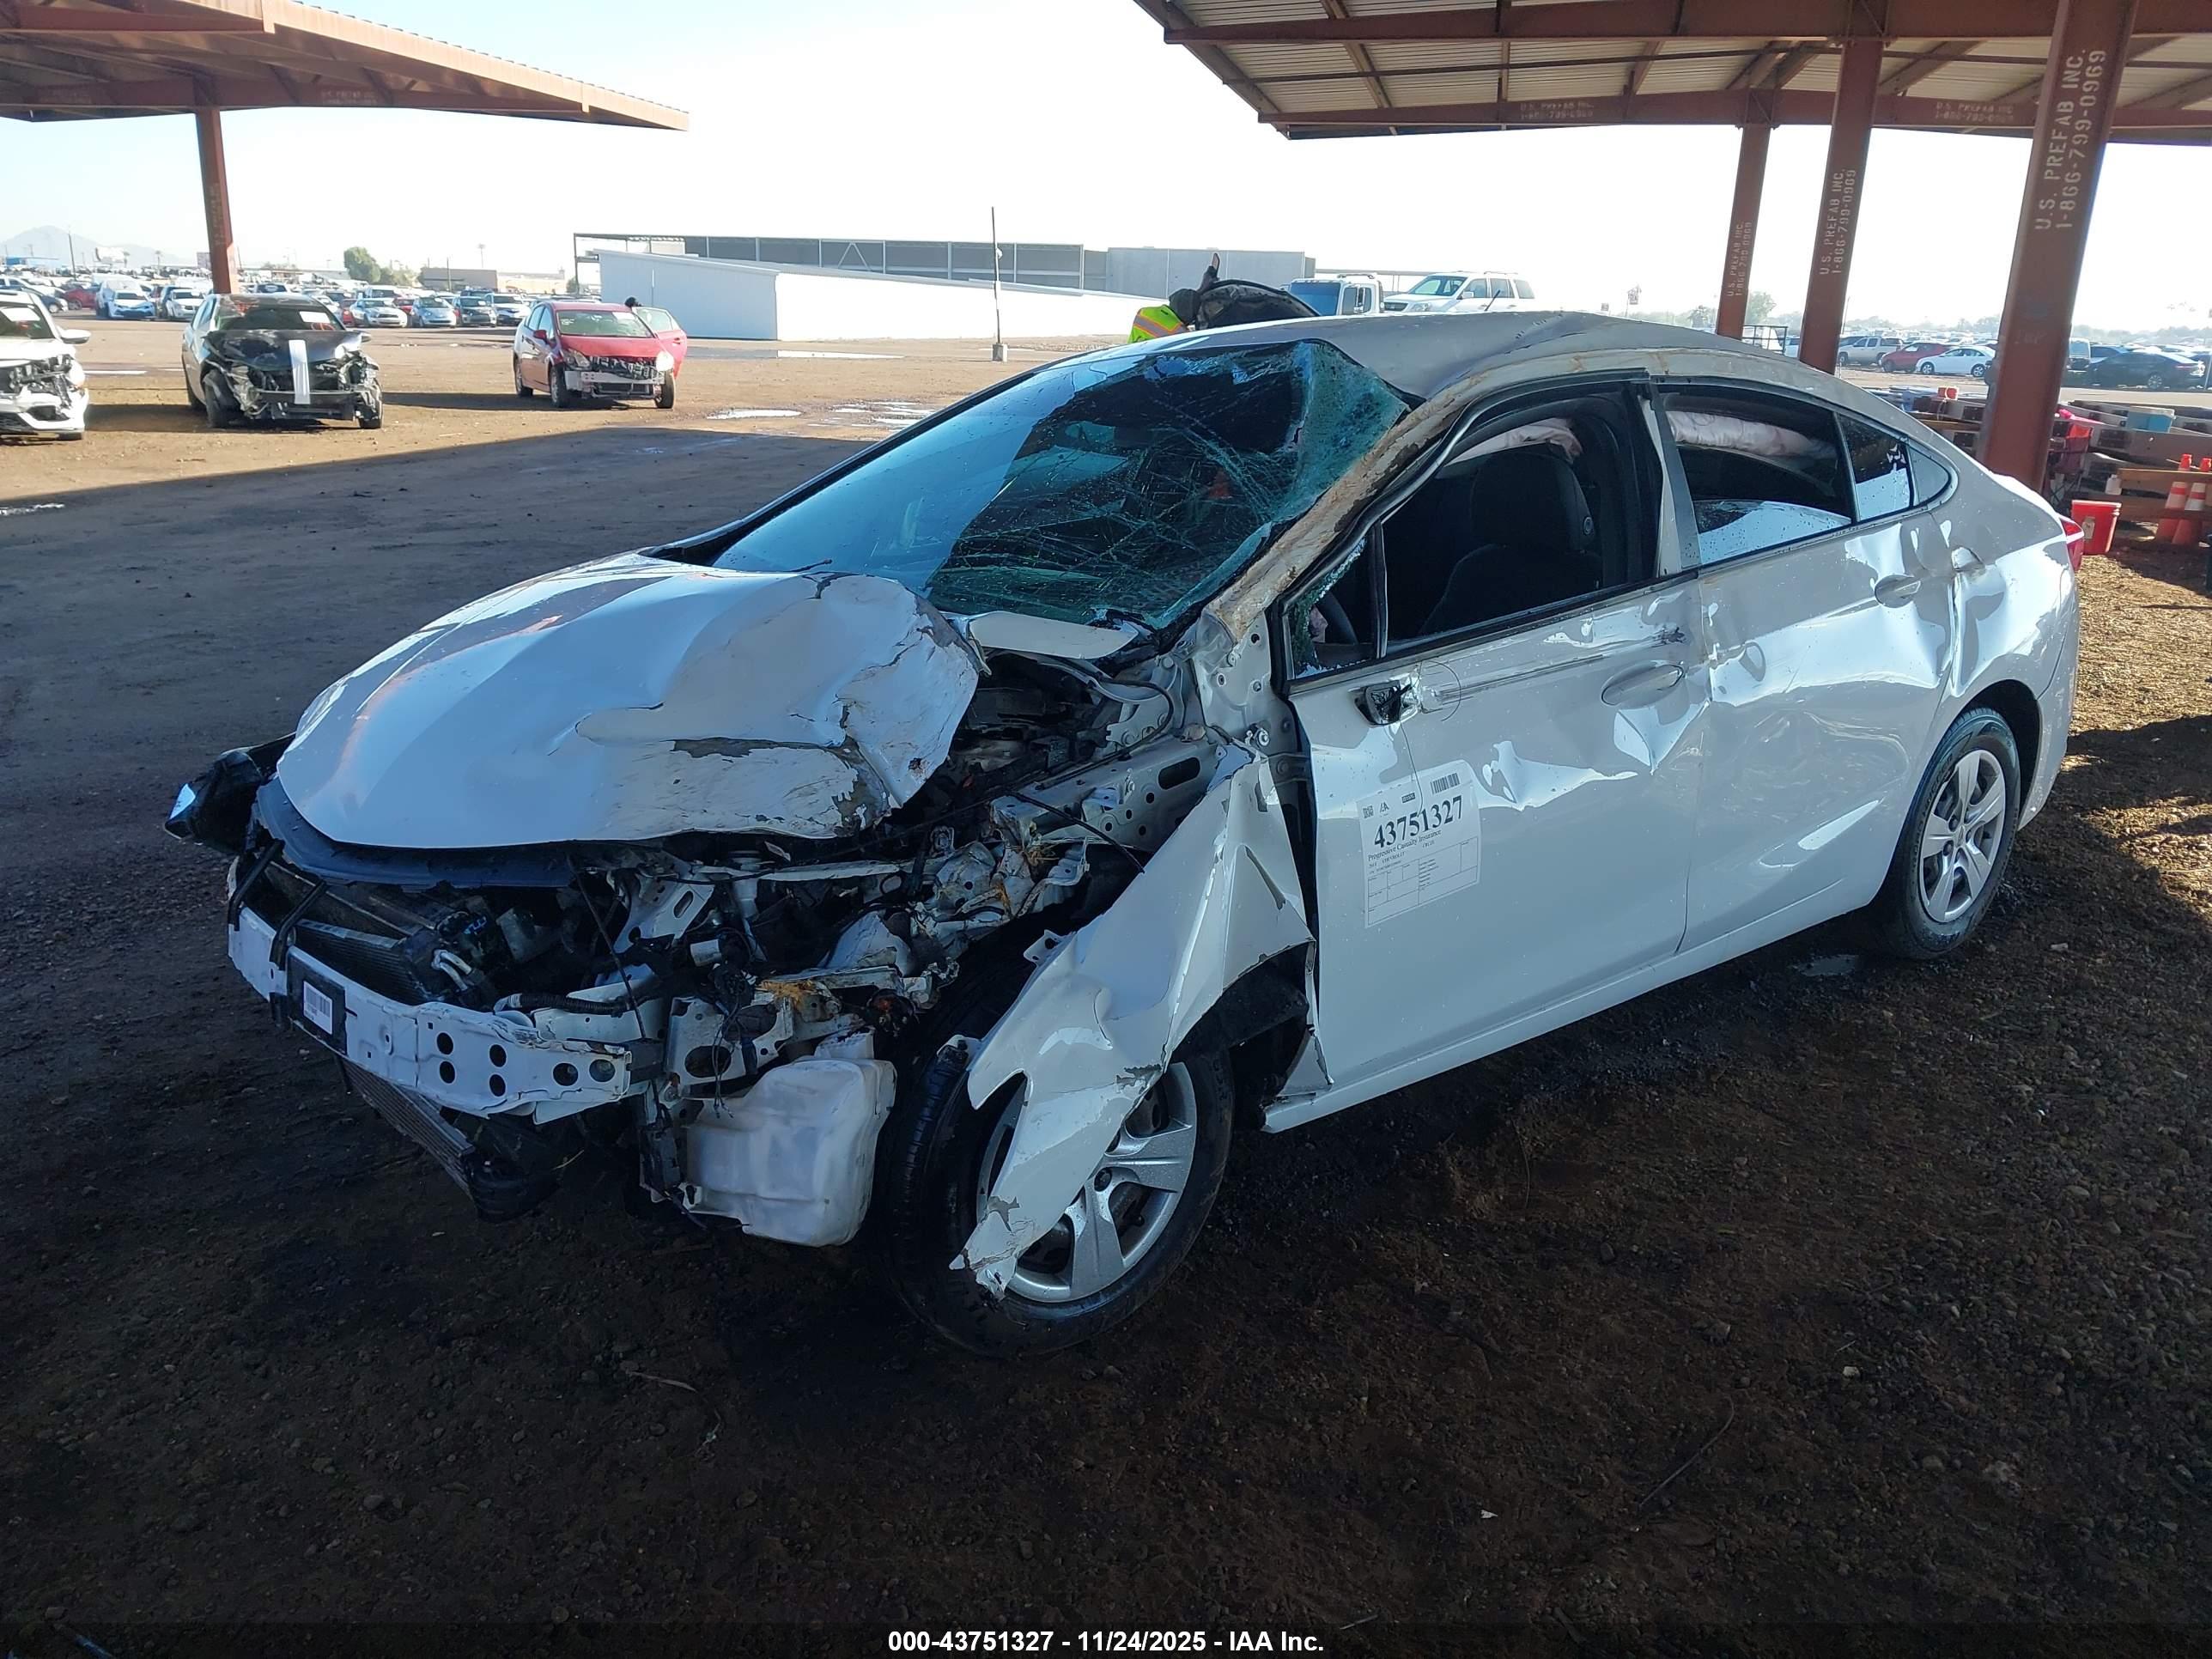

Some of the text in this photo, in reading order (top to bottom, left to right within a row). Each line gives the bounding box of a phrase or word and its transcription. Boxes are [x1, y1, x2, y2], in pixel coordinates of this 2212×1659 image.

[2034, 49, 2086, 230] U.S. PREFAB INC.
[2056, 50, 2106, 228] 1-866-799-0969
[1819, 168, 1845, 275] U.S. PREFAB INC.
[1832, 169, 1856, 274] 1-866-799-0969
[1367, 830, 1442, 862] Progressive Casualty Insurance
[1374, 795, 1462, 848] 43751327
